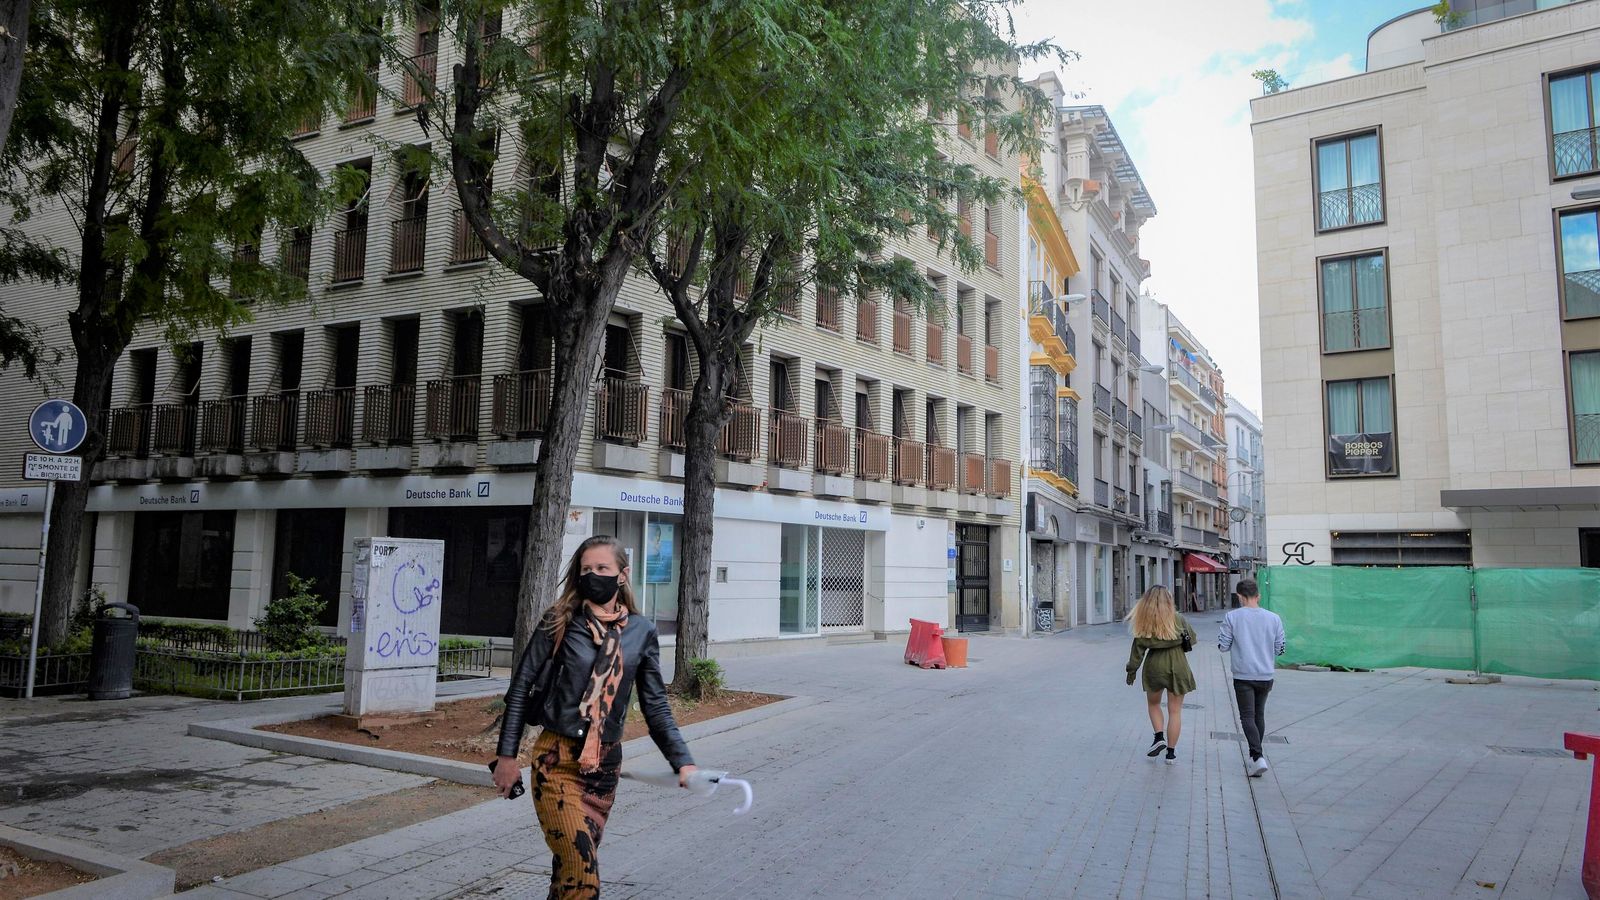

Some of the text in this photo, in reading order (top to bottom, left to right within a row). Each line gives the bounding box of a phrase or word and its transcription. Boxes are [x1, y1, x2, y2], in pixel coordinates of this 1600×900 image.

[1345, 441, 1383, 449] BORGOS
[406, 488, 472, 499] Deutsche Bank
[620, 491, 685, 506] Deutsche Bank
[140, 495, 187, 505] Deutsche Bank
[815, 510, 857, 522] Deutsche Bank
